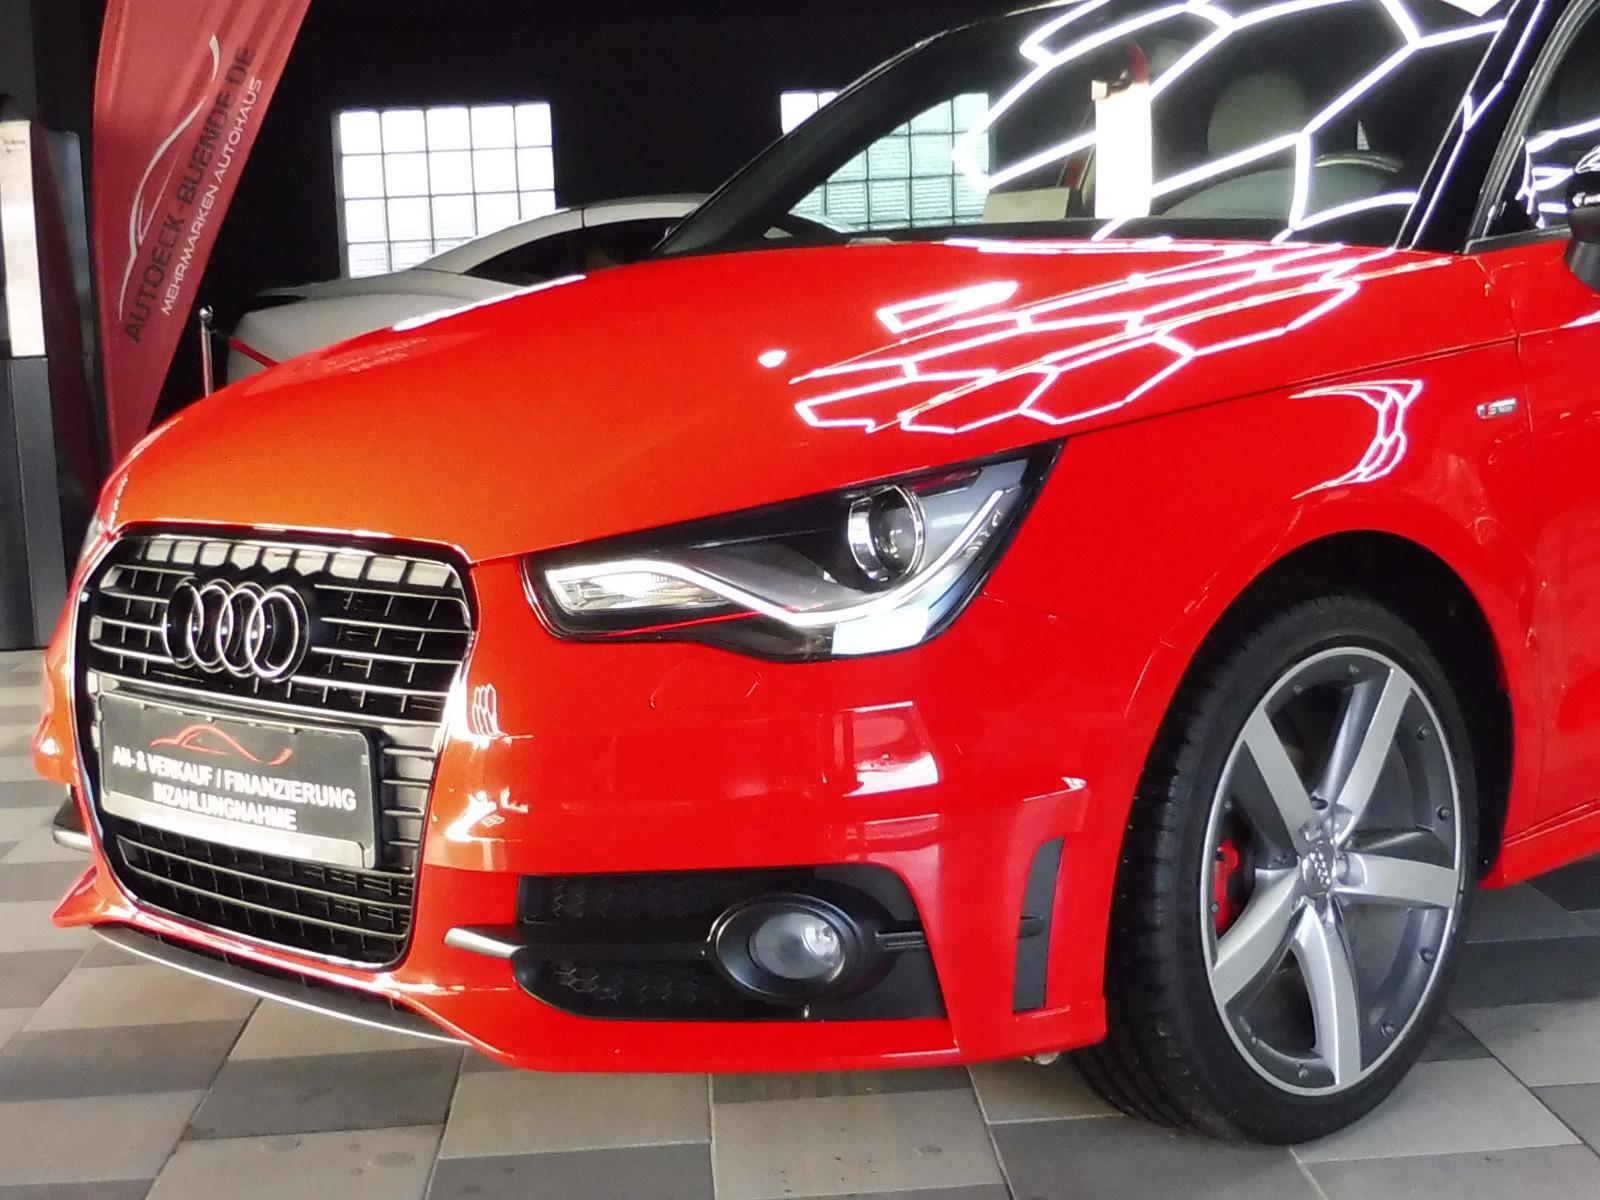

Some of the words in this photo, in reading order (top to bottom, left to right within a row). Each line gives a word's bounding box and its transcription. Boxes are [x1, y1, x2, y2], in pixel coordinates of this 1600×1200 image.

[160, 184, 220, 317] MEHRMARKEN
[213, 76, 263, 183] AUTOHAUS
[146, 752, 214, 787] VERKAUF
[223, 768, 357, 812] FINANZIERUNG
[152, 781, 298, 831] INZAHLUNGNAHME
